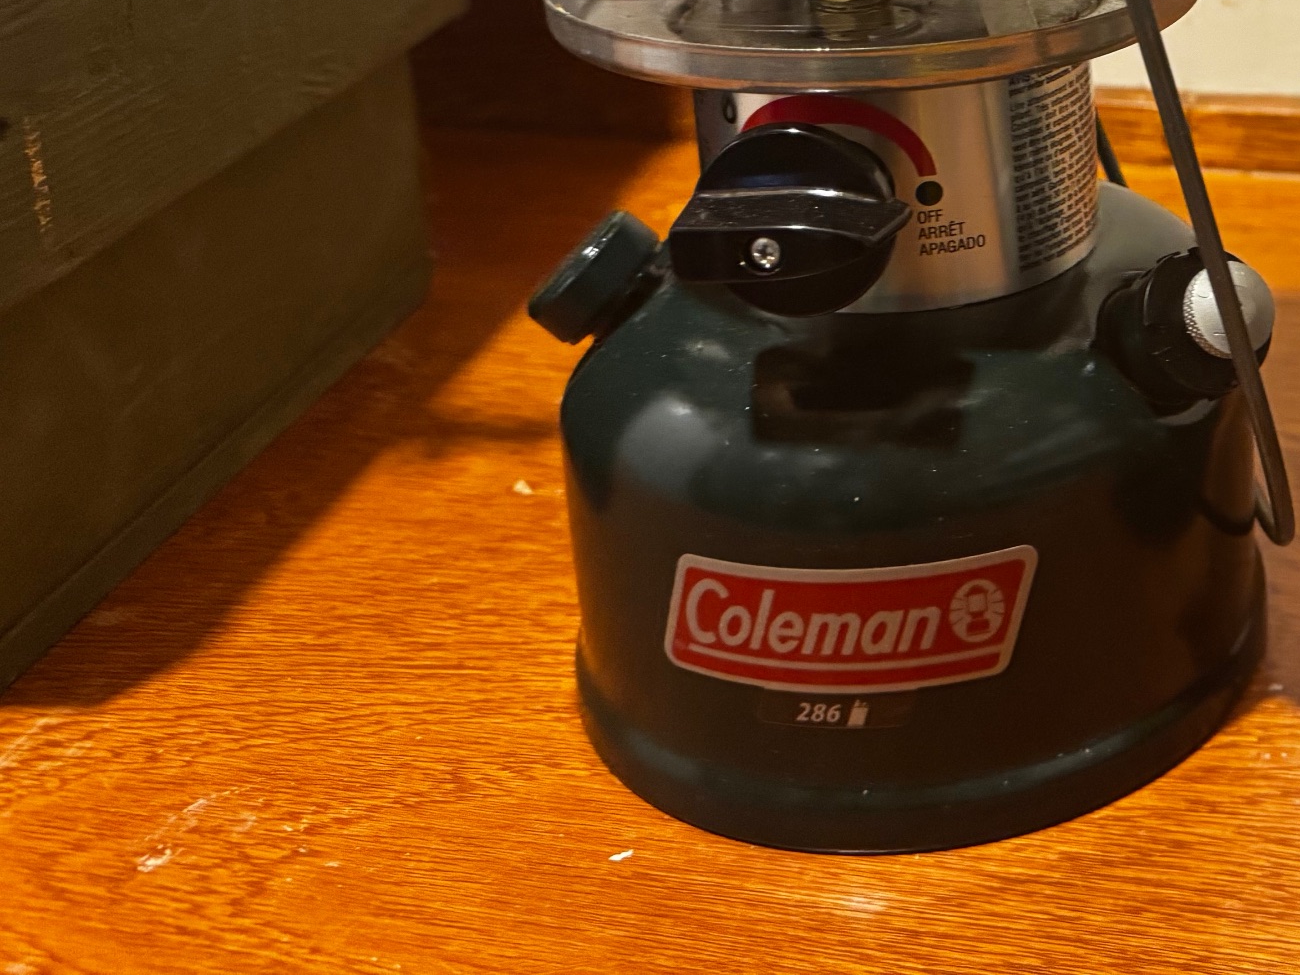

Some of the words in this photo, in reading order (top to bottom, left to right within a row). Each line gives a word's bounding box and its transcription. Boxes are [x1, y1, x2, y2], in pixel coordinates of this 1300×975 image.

[916, 208, 943, 224] OFF
[918, 220, 966, 241] ARRÊT
[919, 234, 986, 257] APAGADO
[685, 577, 941, 656] Coleman
[795, 701, 841, 723] 286
